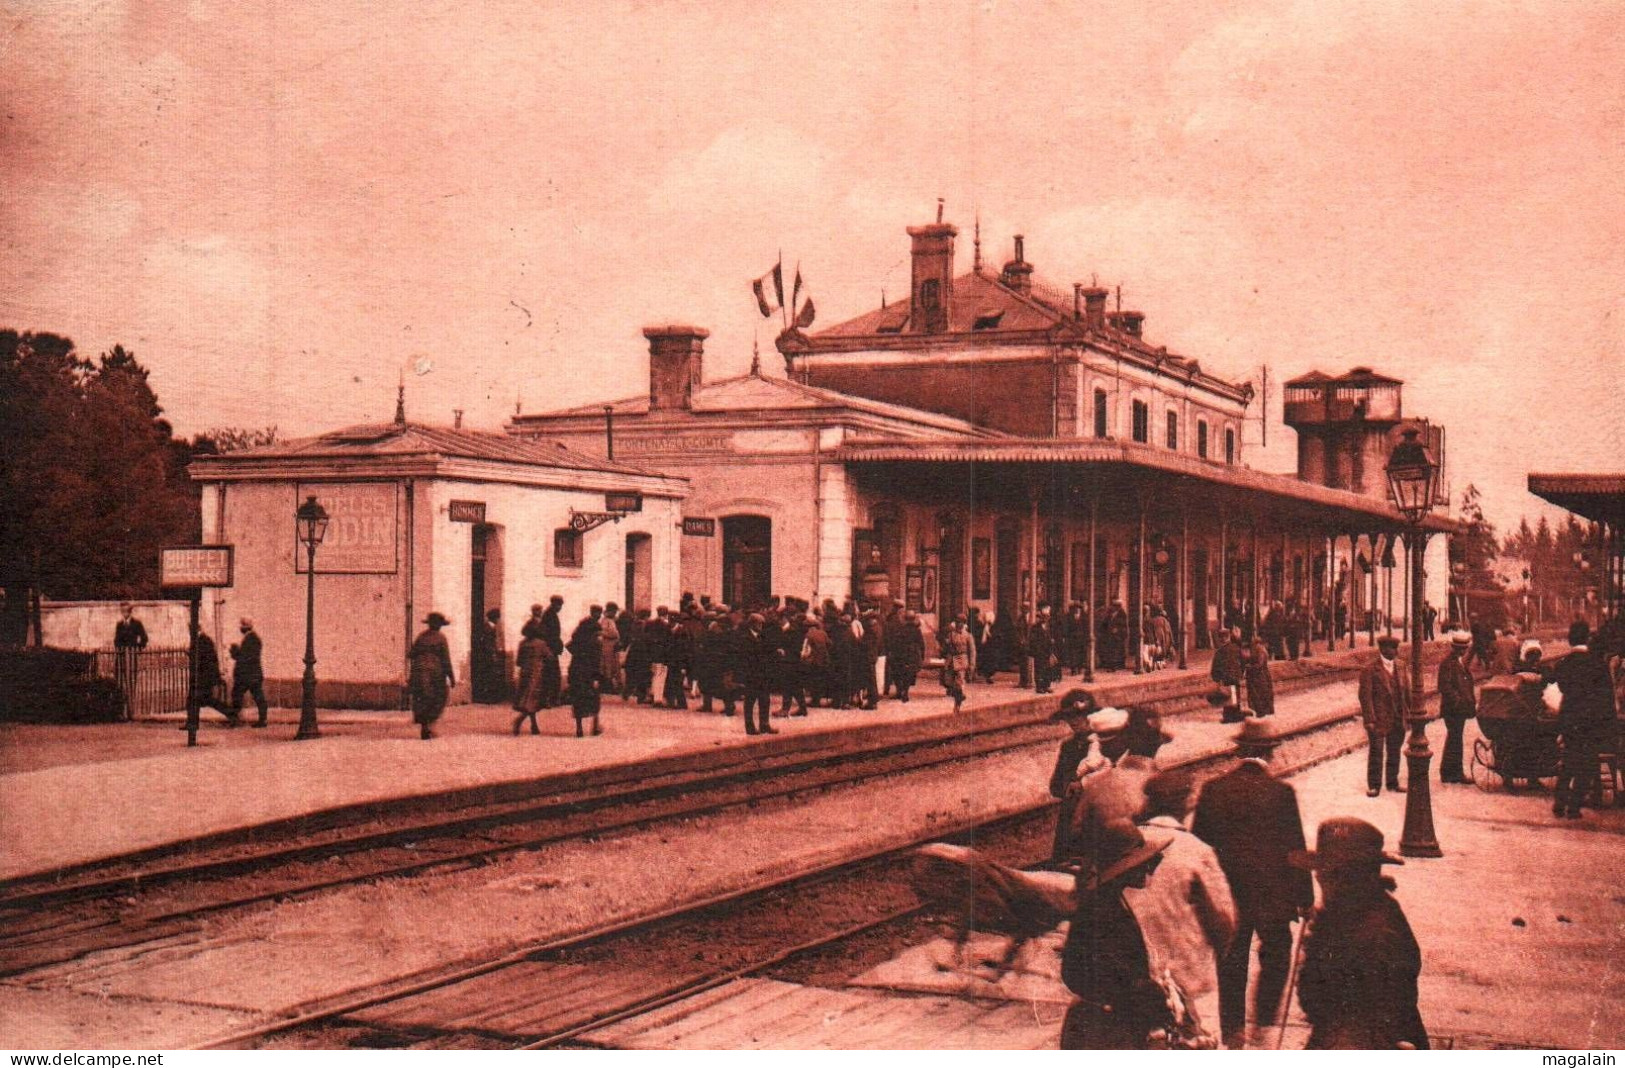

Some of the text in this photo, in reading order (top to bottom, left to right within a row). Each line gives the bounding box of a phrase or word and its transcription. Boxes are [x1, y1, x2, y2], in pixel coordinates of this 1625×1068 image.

[322, 516, 392, 547] ODIN
[685, 520, 712, 532] DAMES
[165, 551, 225, 568] BUFFET
